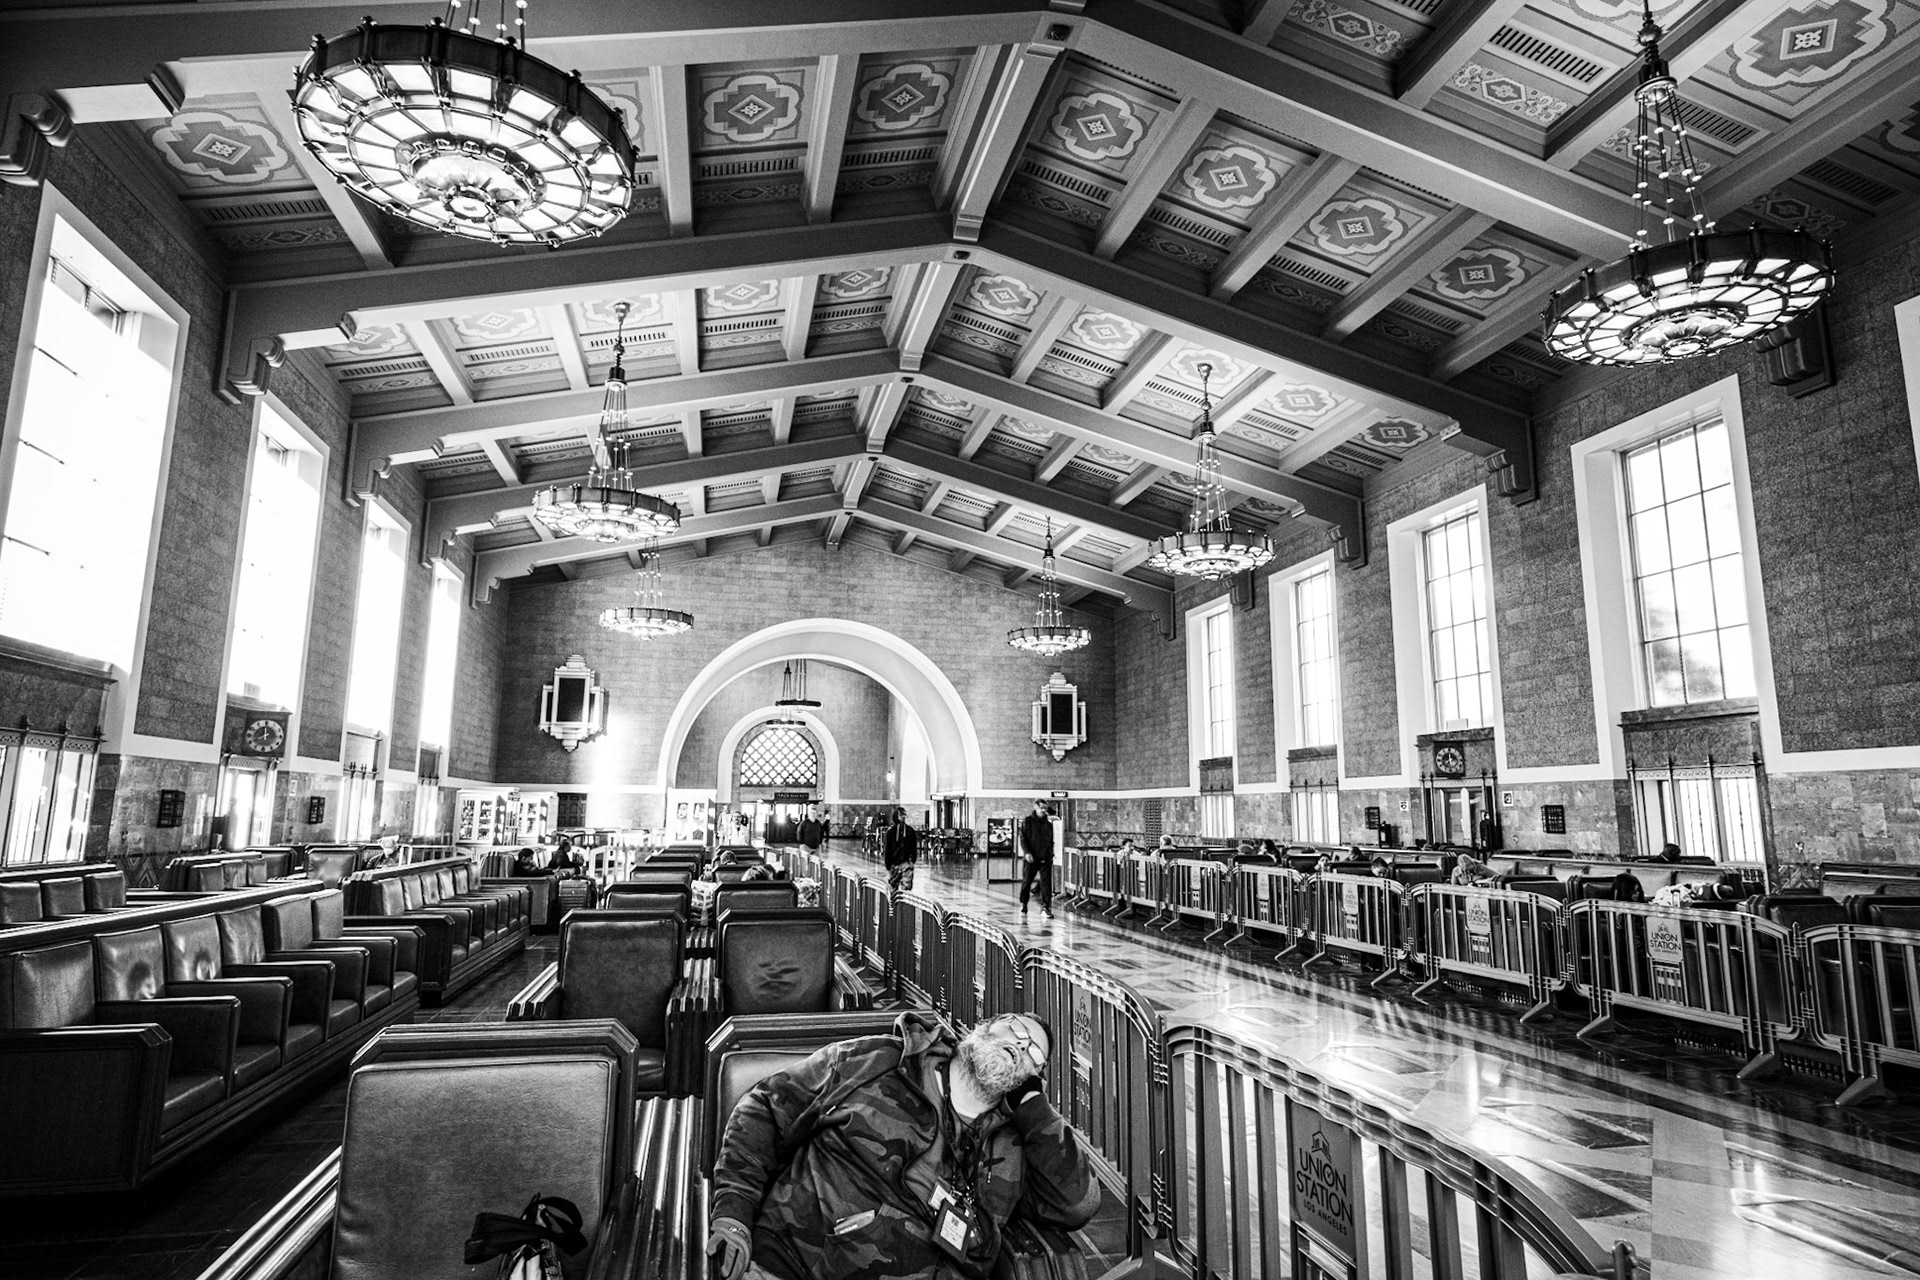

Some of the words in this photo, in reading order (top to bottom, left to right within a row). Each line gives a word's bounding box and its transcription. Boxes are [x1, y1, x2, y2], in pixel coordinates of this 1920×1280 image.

[1650, 940, 1682, 951] STATION
[1651, 932, 1678, 942] UNION
[1299, 1147, 1348, 1197] UNION
[1296, 1170, 1353, 1227] STATION
[1303, 1198, 1316, 1214] LOS
[1317, 1209, 1348, 1236] ANGELES
